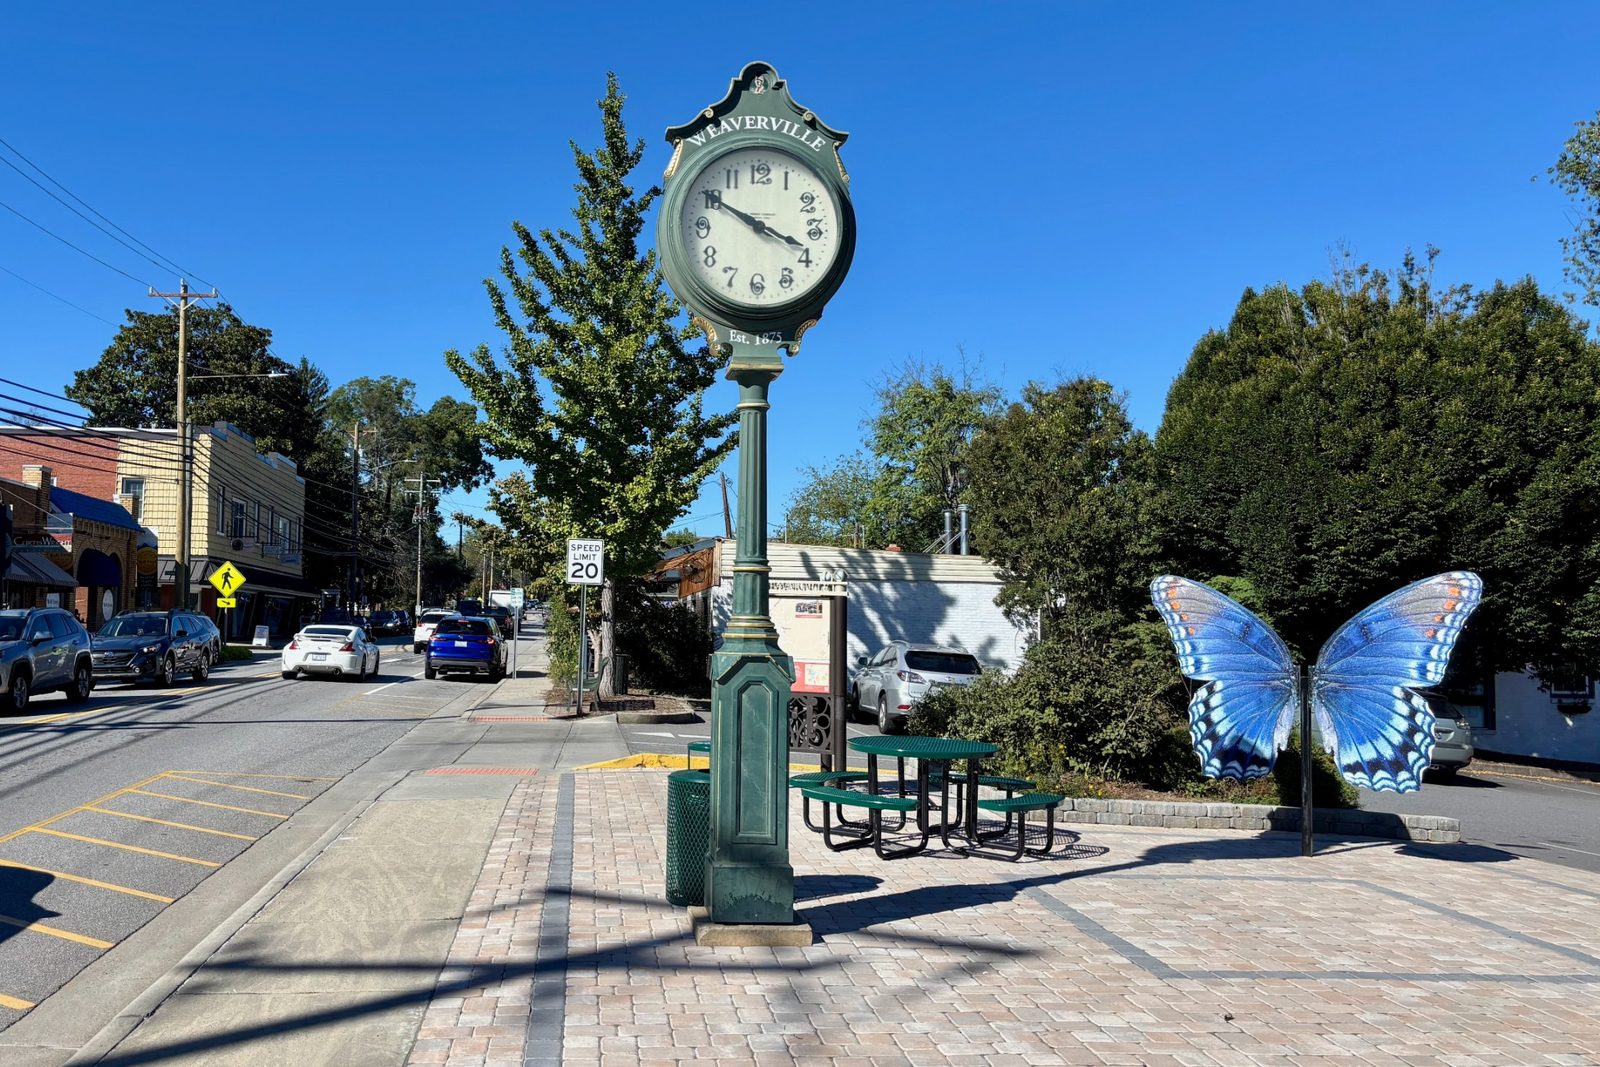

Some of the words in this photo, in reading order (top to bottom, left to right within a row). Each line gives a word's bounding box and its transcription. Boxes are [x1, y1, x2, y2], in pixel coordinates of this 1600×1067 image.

[685, 115, 826, 152] WEAVERVILLE
[726, 169, 740, 189] 11
[750, 163, 772, 185] 12
[783, 170, 789, 191] 1
[800, 191, 816, 213] 2
[695, 216, 711, 239] 9
[806, 218, 823, 241] 3
[703, 245, 717, 267] 8
[797, 247, 812, 268] 4
[722, 266, 738, 288] 7
[750, 273, 765, 295] 6
[779, 267, 794, 289] 5
[729, 329, 750, 344] Est.
[754, 331, 782, 345] 1875
[571, 544, 601, 552] SPEED
[573, 553, 597, 561] LIMIT
[571, 562, 598, 579] 20
